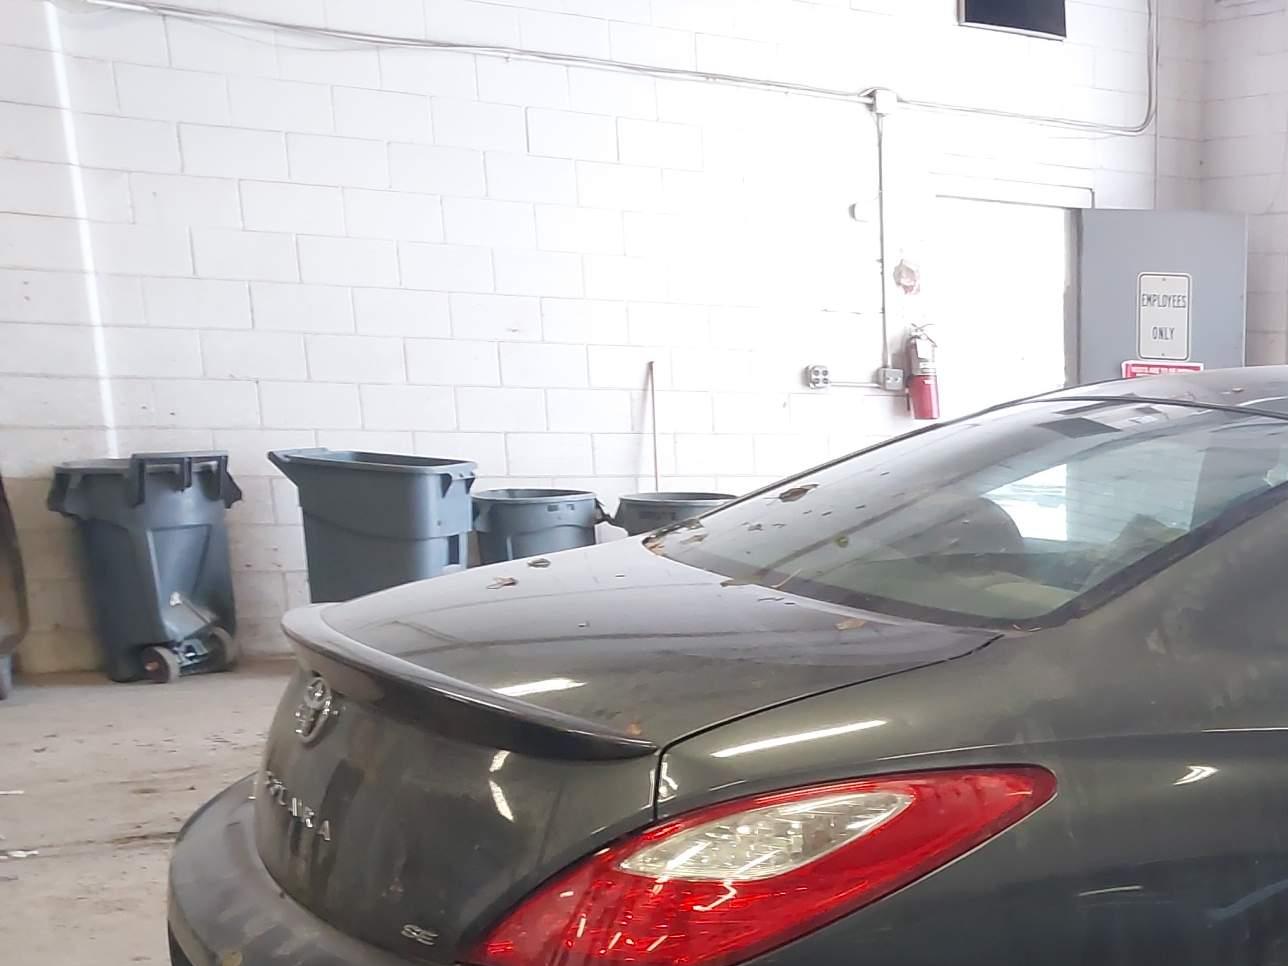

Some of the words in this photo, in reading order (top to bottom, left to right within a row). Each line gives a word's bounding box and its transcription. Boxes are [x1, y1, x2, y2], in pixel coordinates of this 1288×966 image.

[1142, 293, 1187, 308] EMPLOYEES
[1152, 326, 1175, 340] ONLY
[400, 924, 439, 946] SE
